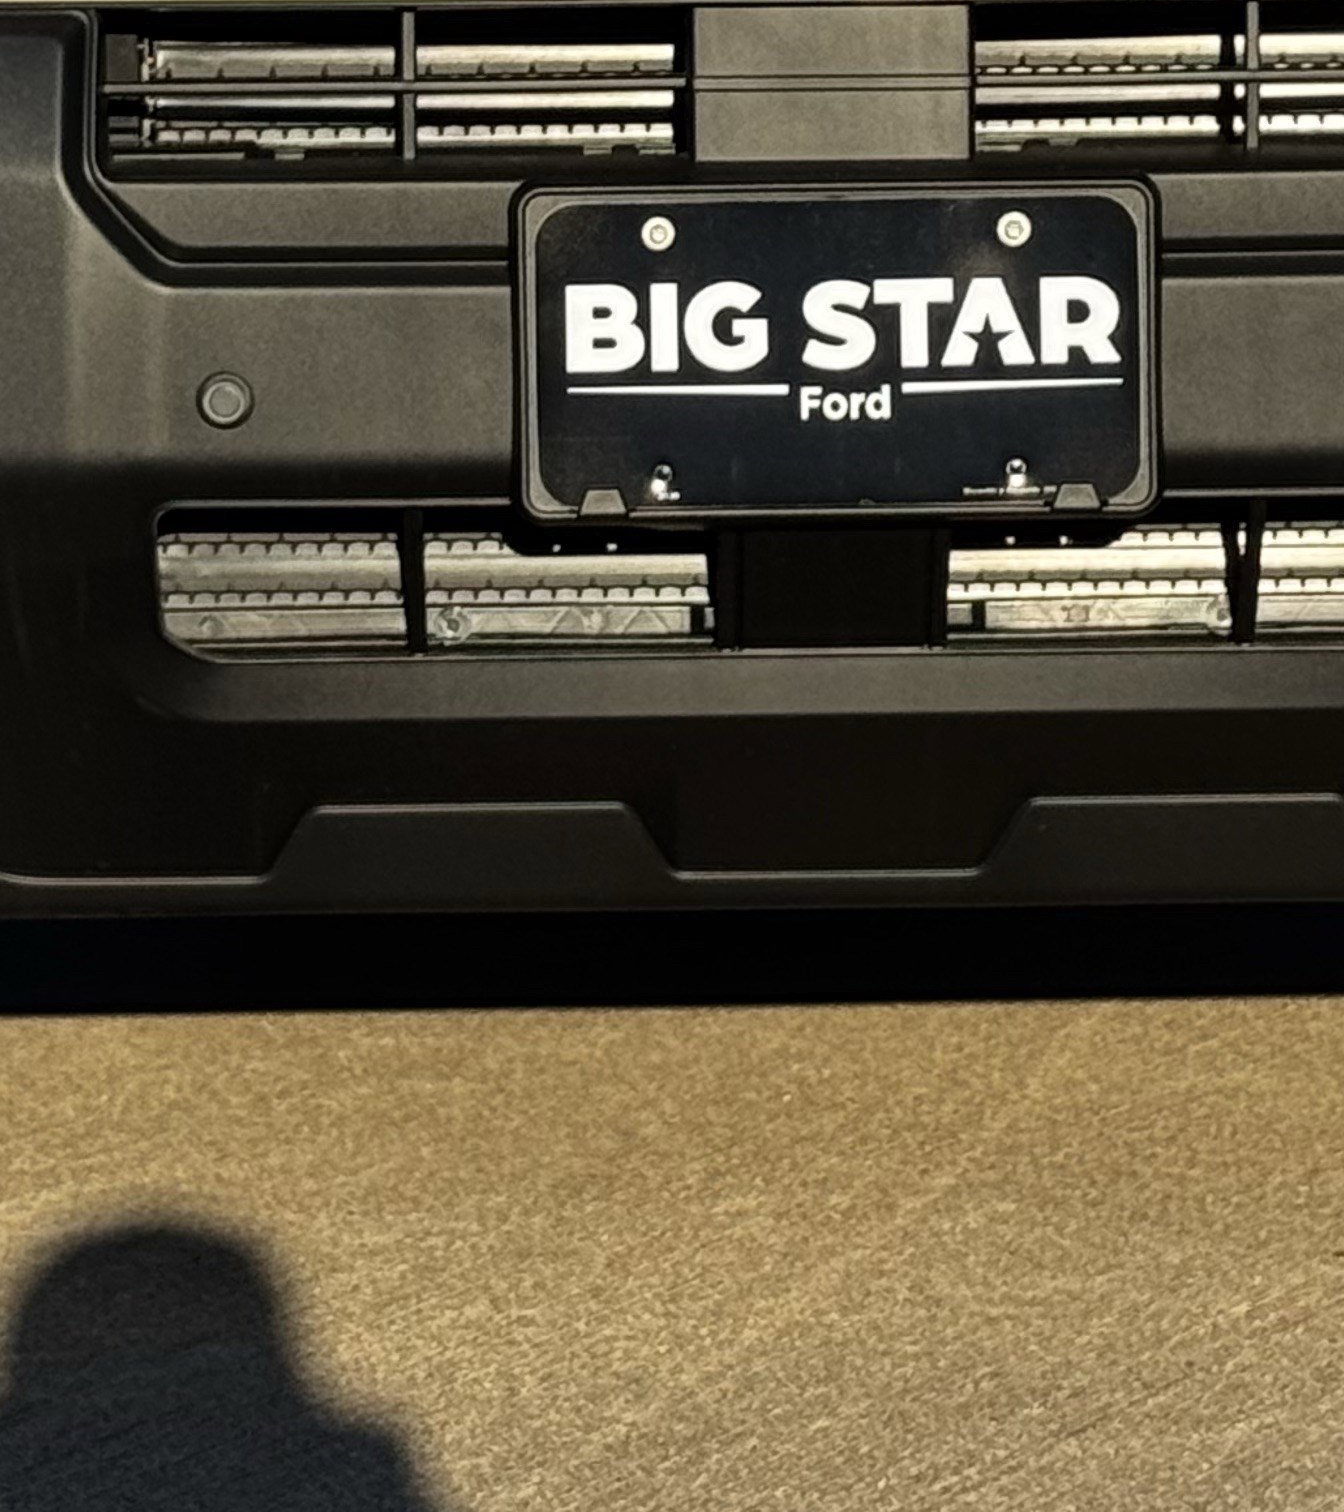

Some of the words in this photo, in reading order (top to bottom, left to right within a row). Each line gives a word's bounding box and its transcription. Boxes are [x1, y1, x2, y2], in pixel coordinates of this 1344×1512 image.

[565, 280, 769, 374] BIG
[801, 276, 1122, 371] STAR
[800, 384, 893, 421] Ford
